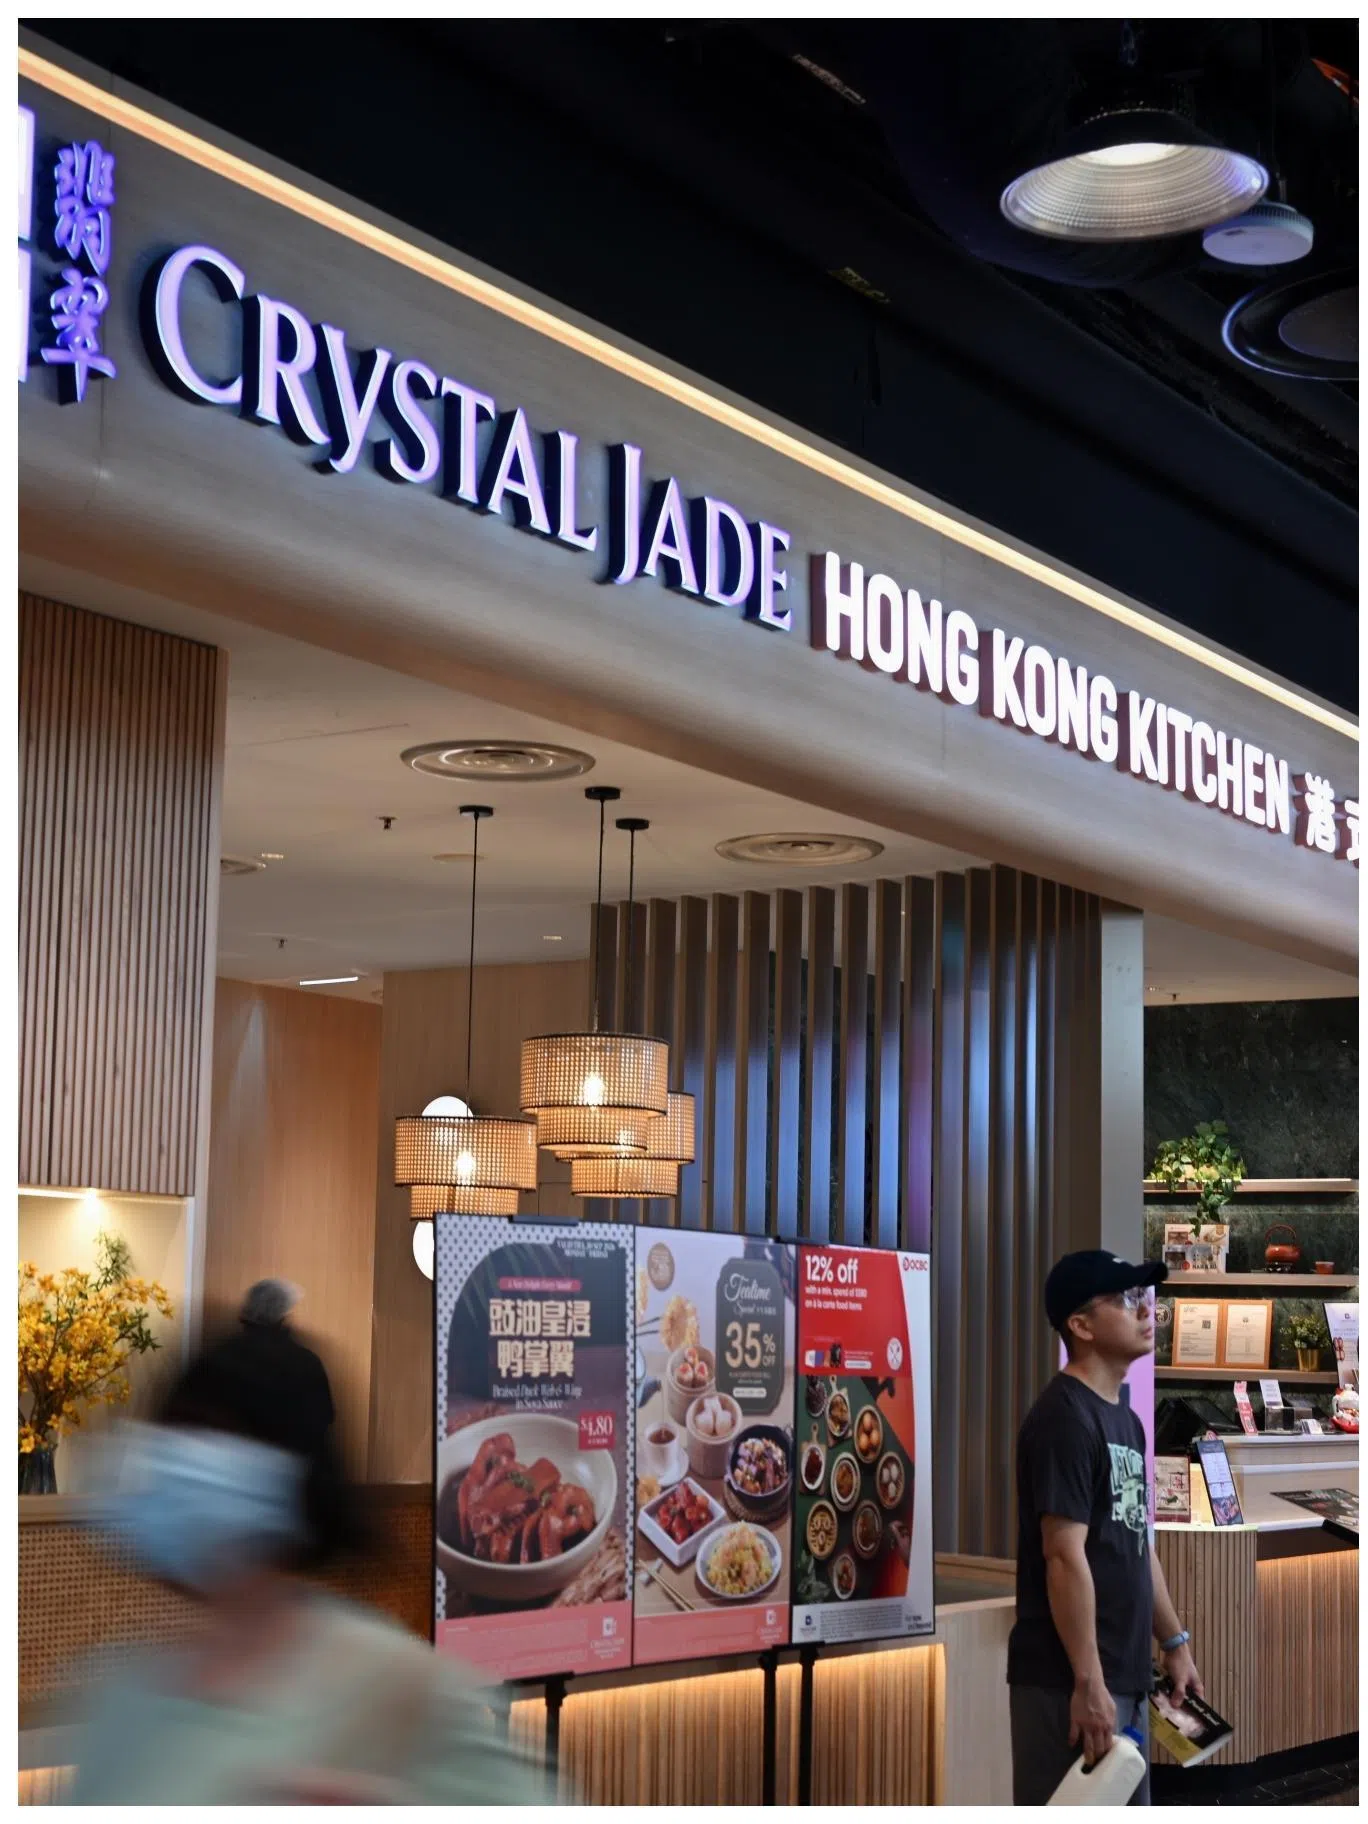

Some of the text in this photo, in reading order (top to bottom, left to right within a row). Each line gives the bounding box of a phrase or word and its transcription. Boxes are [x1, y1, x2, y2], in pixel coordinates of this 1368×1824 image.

[154, 244, 792, 632] CRYSTAL JADE
[824, 550, 1291, 835] HONG KONG KITCHEN
[805, 1254, 859, 1285] 12% off
[910, 1259, 929, 1271] OCBC
[762, 1355, 777, 1367] OFF
